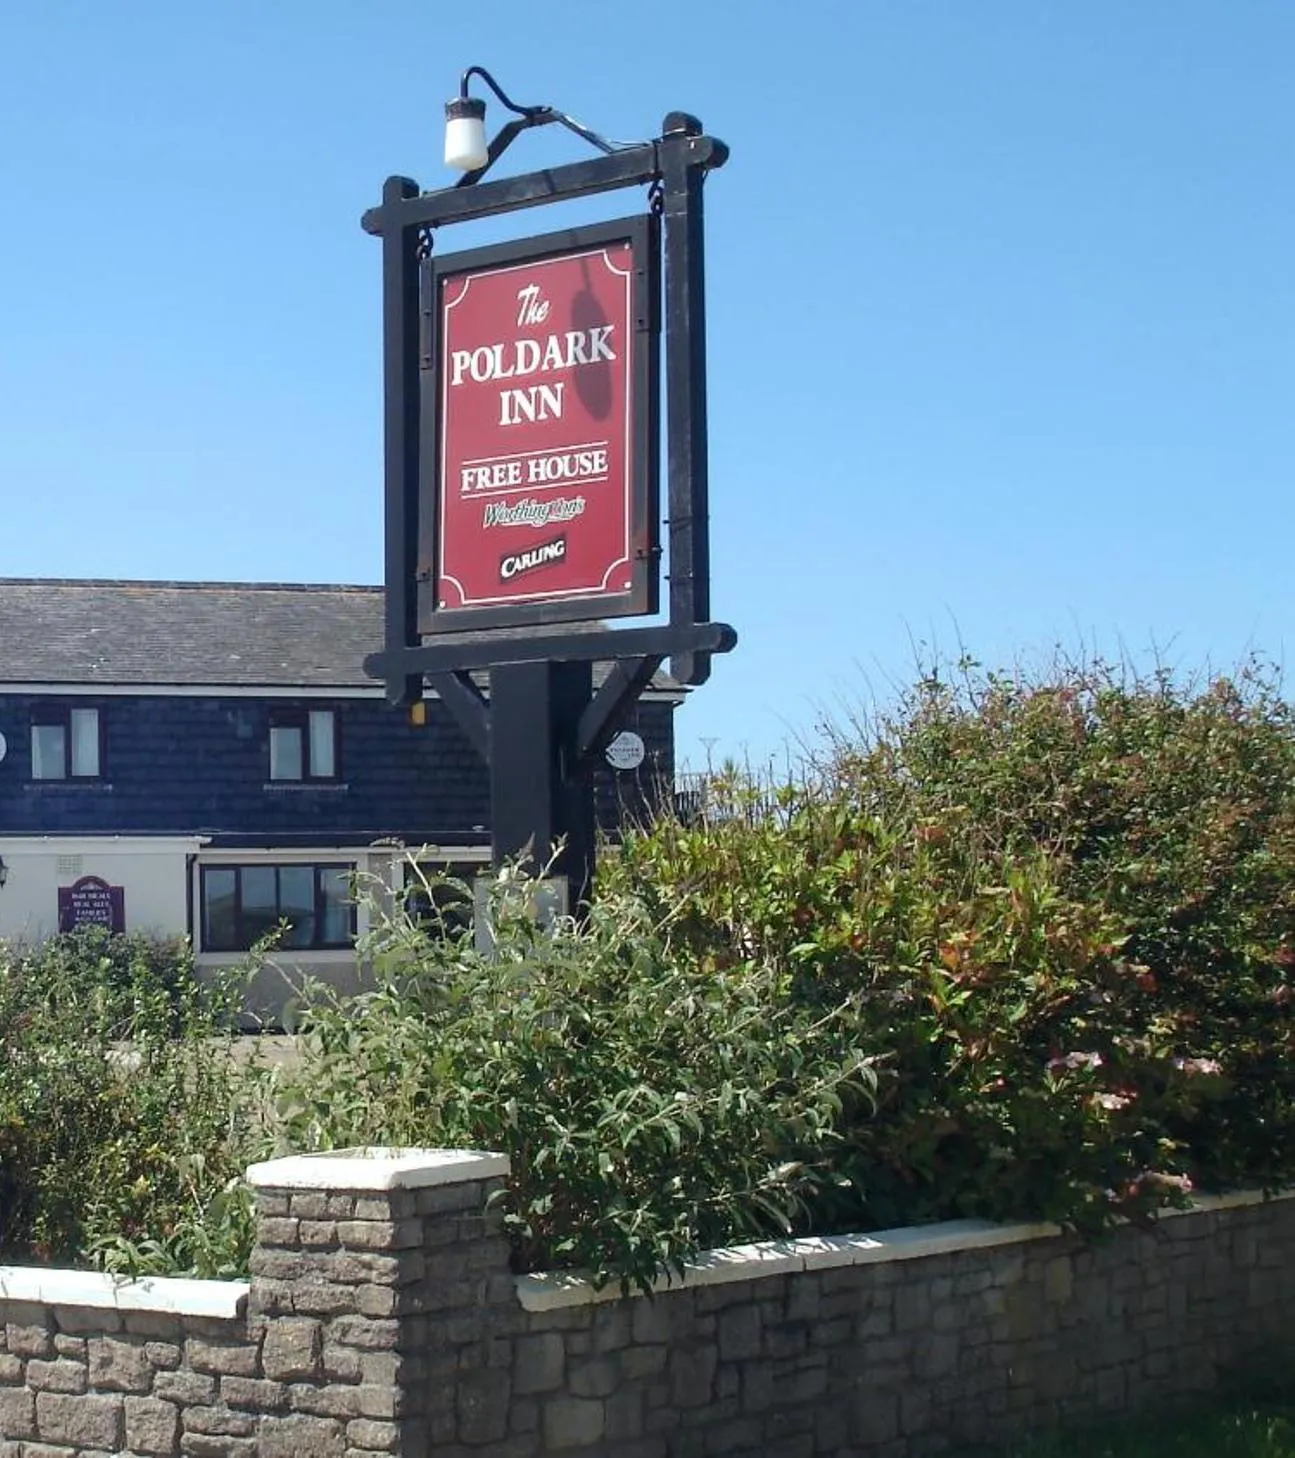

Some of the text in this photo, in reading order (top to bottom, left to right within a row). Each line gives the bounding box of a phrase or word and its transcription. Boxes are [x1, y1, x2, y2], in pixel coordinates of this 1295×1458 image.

[516, 283, 551, 327] The
[451, 325, 617, 386] POLDARK
[498, 382, 564, 427] INN
[461, 450, 608, 493] FREE HOUSE
[500, 540, 565, 579] CARLING
